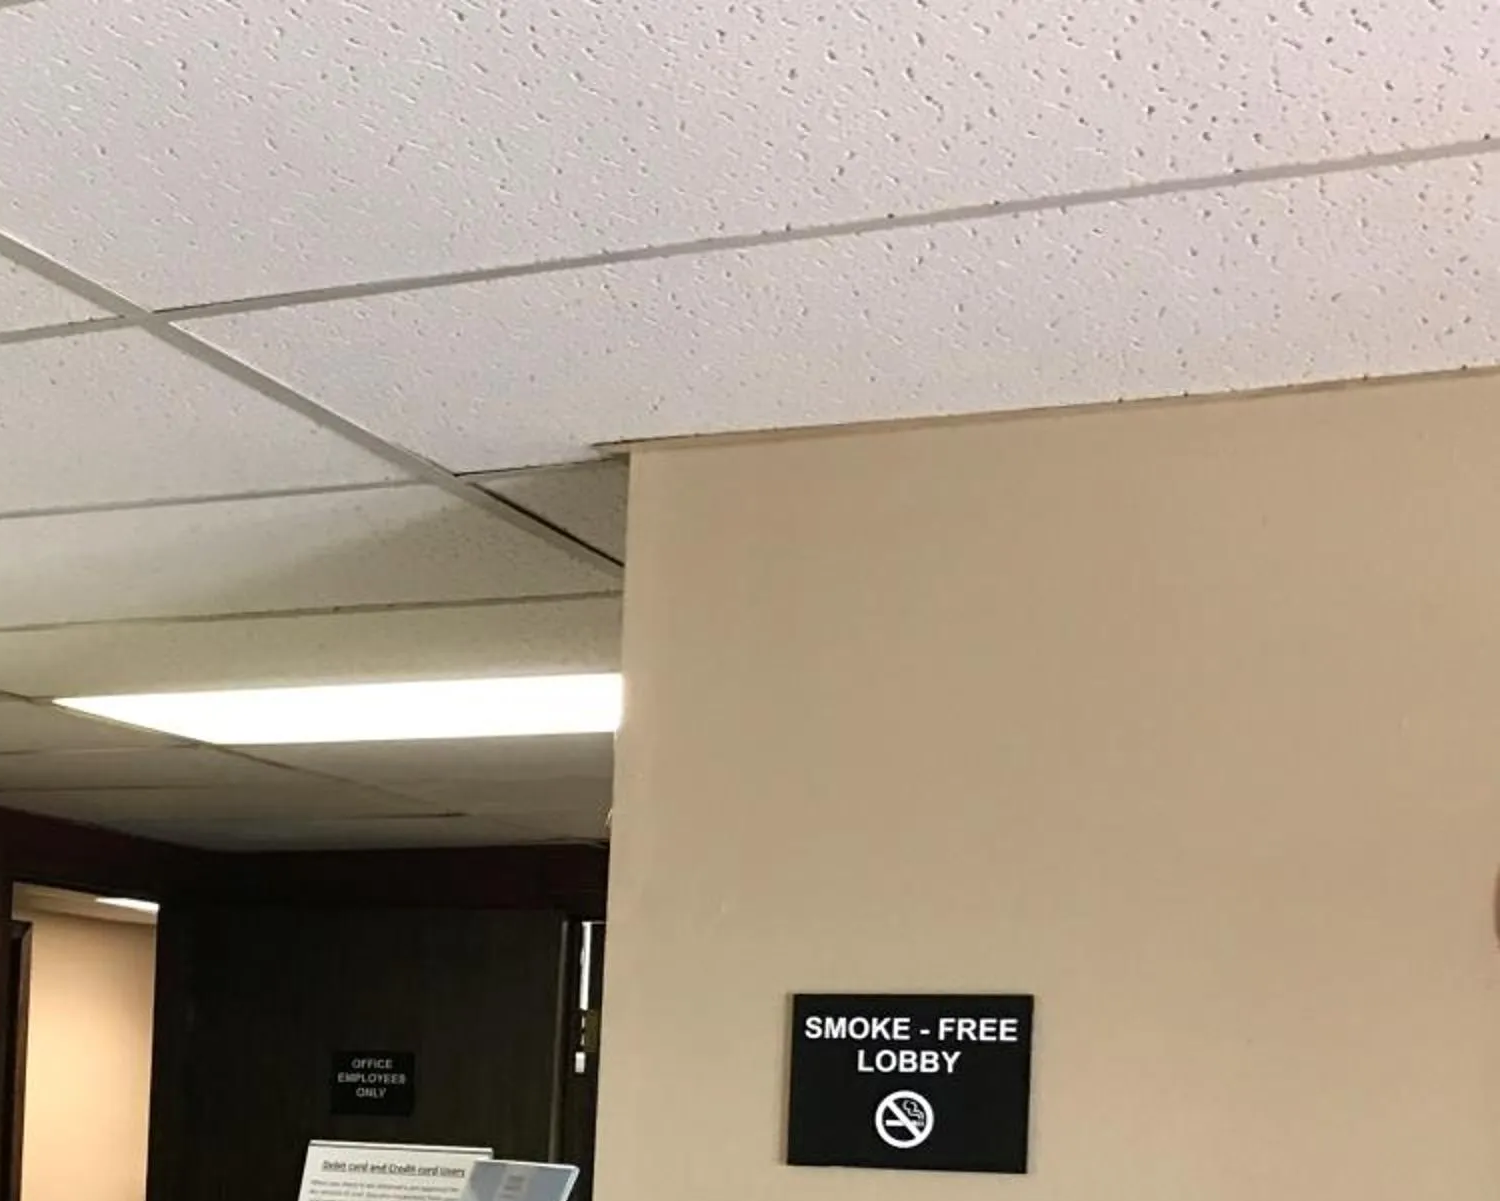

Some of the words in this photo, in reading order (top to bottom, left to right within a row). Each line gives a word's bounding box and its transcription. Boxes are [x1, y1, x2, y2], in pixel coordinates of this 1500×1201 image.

[804, 1016, 912, 1041] SMOKE
[938, 1018, 1019, 1042] FREE
[351, 1058, 392, 1069] OFFICE
[856, 1049, 962, 1074] LOBBY
[355, 1087, 386, 1098] ONLY
